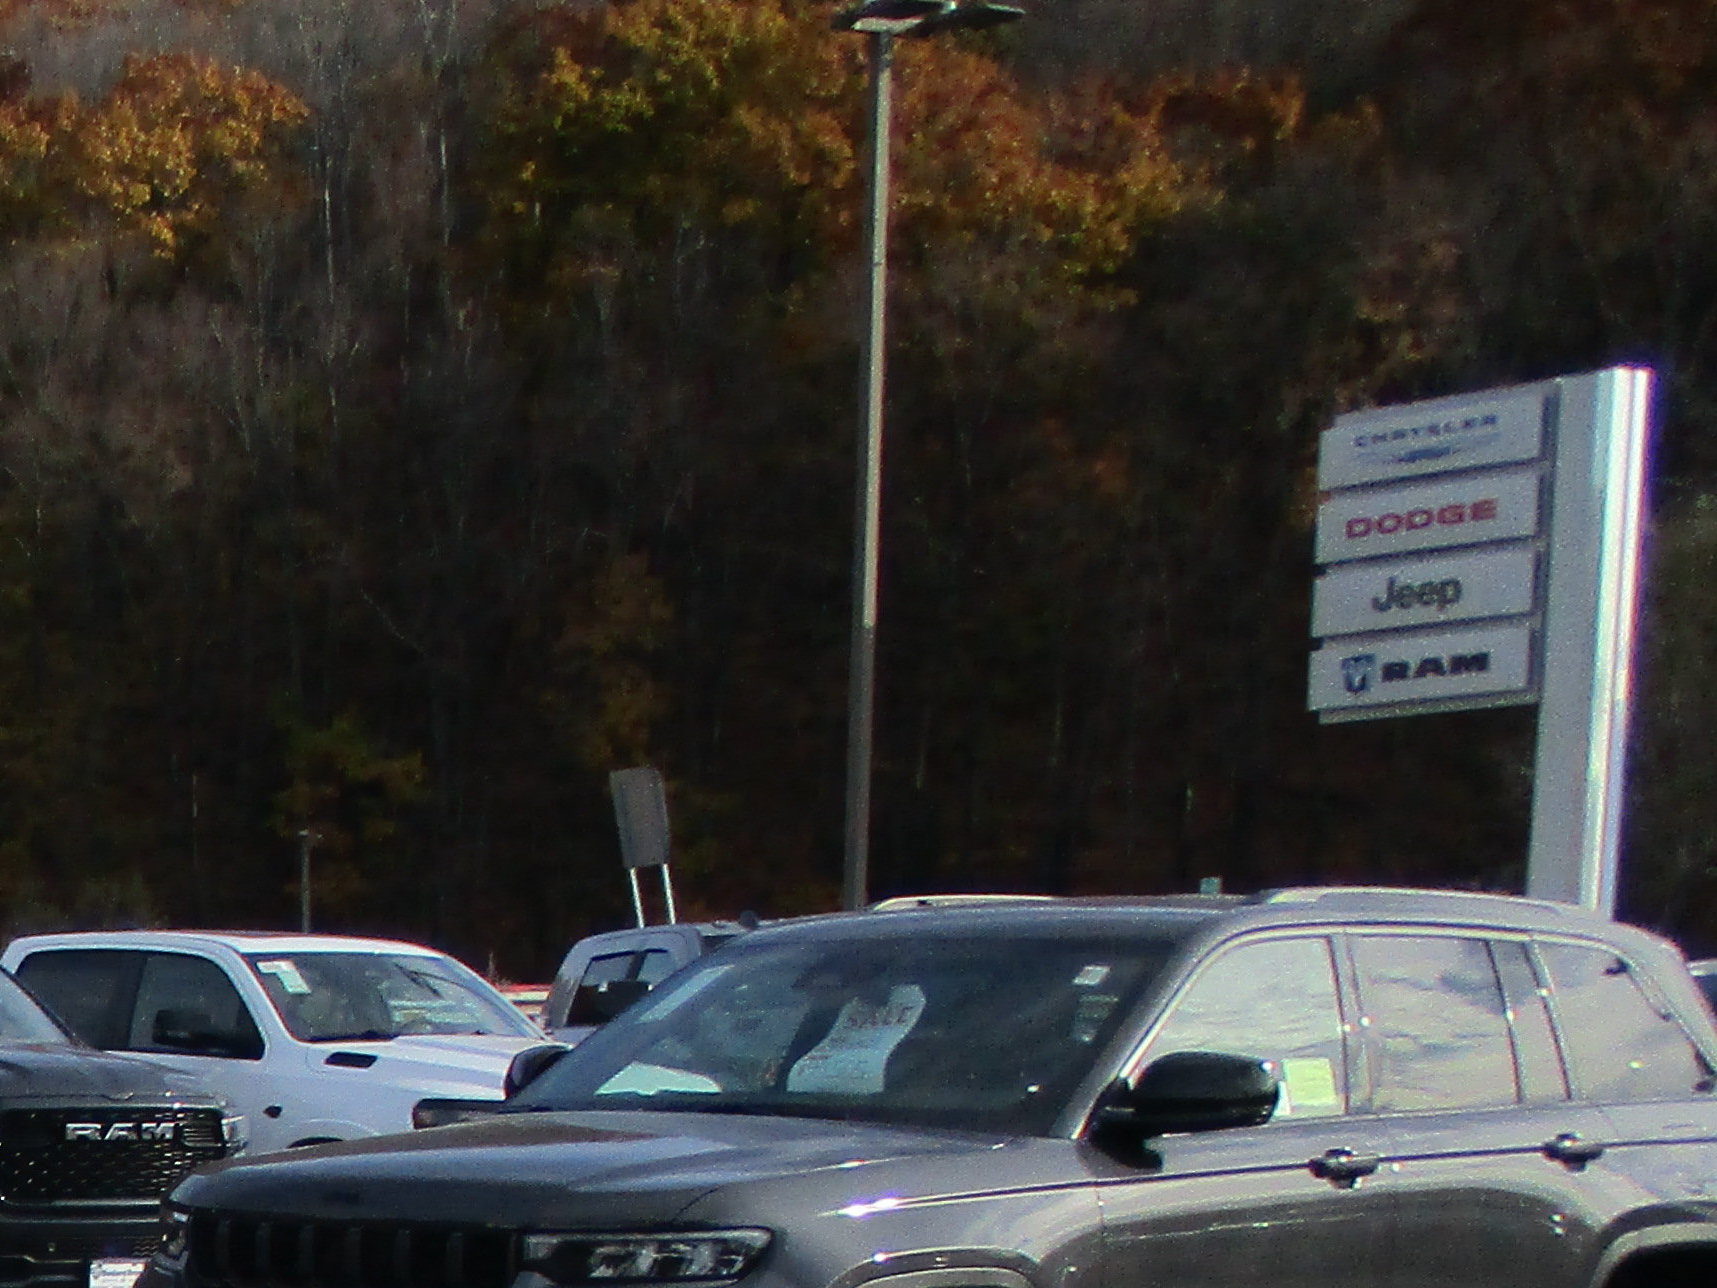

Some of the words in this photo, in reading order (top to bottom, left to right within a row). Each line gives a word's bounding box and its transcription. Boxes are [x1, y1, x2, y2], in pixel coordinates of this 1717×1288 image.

[1346, 499, 1499, 539] DODGE
[1372, 576, 1462, 613] Jeep
[1381, 652, 1490, 683] RAM
[66, 1122, 175, 1141] RAM
